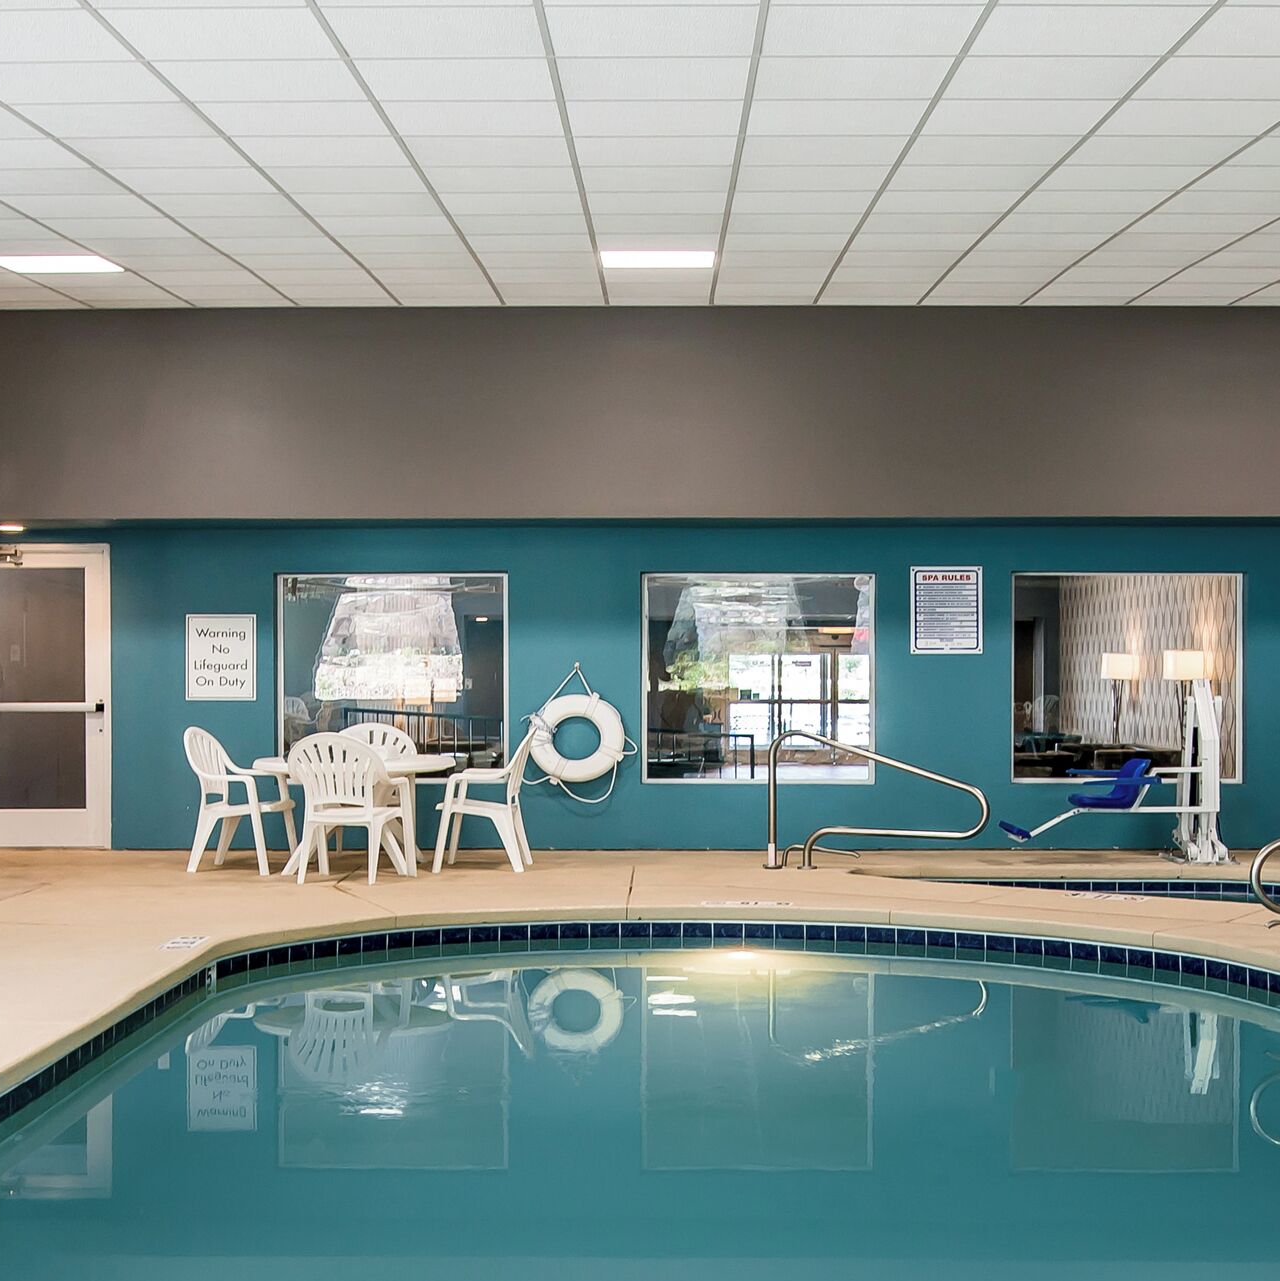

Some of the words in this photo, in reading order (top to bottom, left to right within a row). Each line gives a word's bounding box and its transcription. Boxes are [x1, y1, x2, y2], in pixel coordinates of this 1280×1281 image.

[941, 574, 971, 582] RULES
[196, 627, 246, 641] Warning
[212, 644, 230, 654] No
[194, 658, 248, 673] Lifeguard
[195, 675, 214, 687] On
[219, 675, 246, 689] Duty
